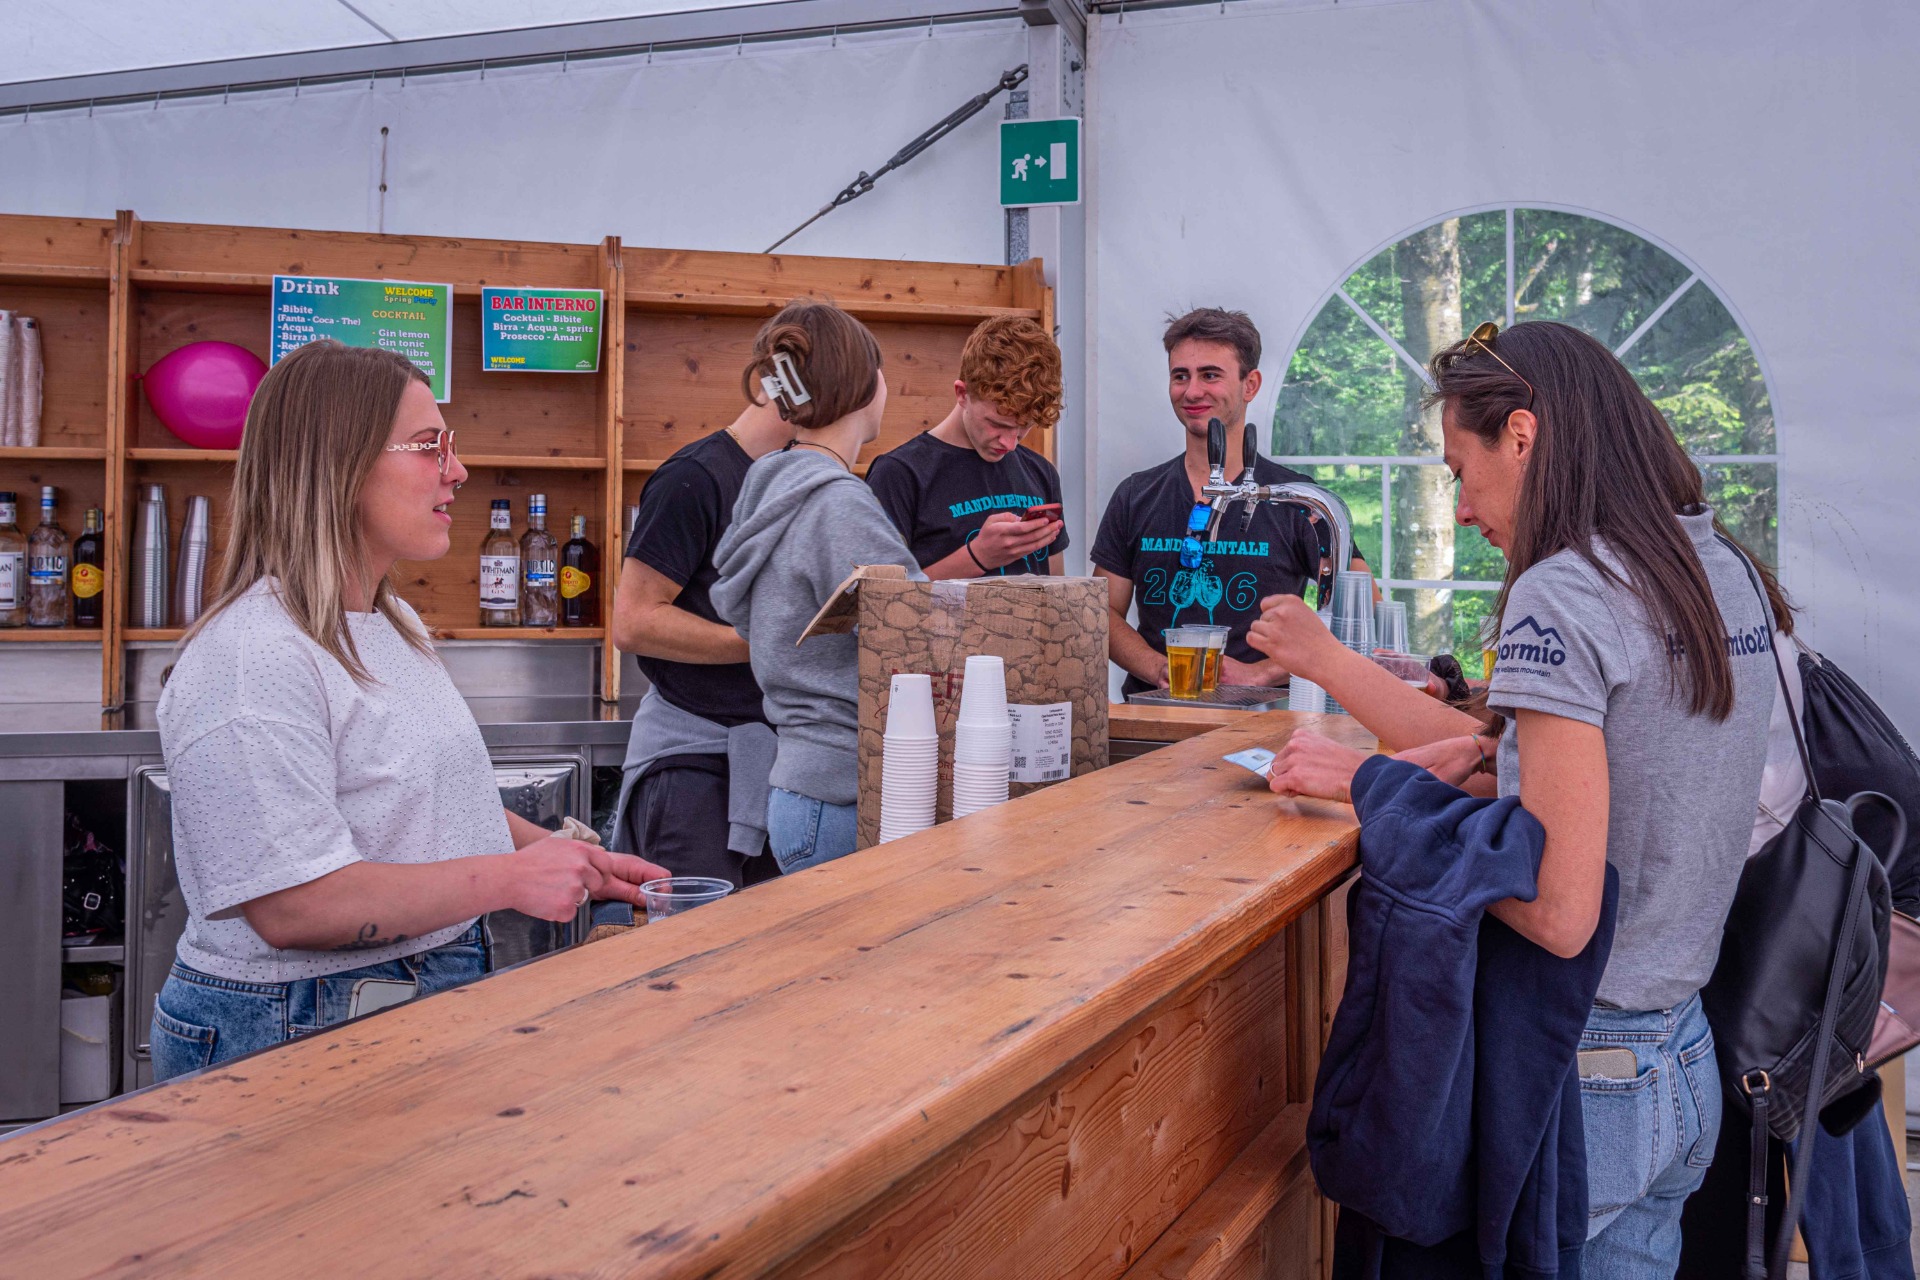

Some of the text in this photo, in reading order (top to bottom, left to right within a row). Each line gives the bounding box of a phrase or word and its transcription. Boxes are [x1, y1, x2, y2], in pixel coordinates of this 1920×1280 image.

[281, 279, 340, 295] Drink
[384, 286, 434, 297] WELCOME
[384, 296, 412, 304] Spring
[491, 296, 597, 312] BAR INTERNO
[278, 314, 306, 323] (Fanta
[312, 316, 334, 324] Coca
[341, 317, 360, 326] The)
[372, 310, 426, 320] COCKTAIL
[503, 314, 544, 322] Cocktail
[553, 315, 582, 323] Bibite
[378, 328, 396, 337] Gin
[399, 330, 430, 338] lemon
[527, 324, 558, 333] Acqua
[500, 332, 544, 340] Prosecco
[553, 334, 582, 342] Amari
[378, 338, 396, 347] Gin
[406, 348, 430, 356] libre
[482, 566, 514, 574] WHITMAN
[1520, 667, 1550, 677] mountain
